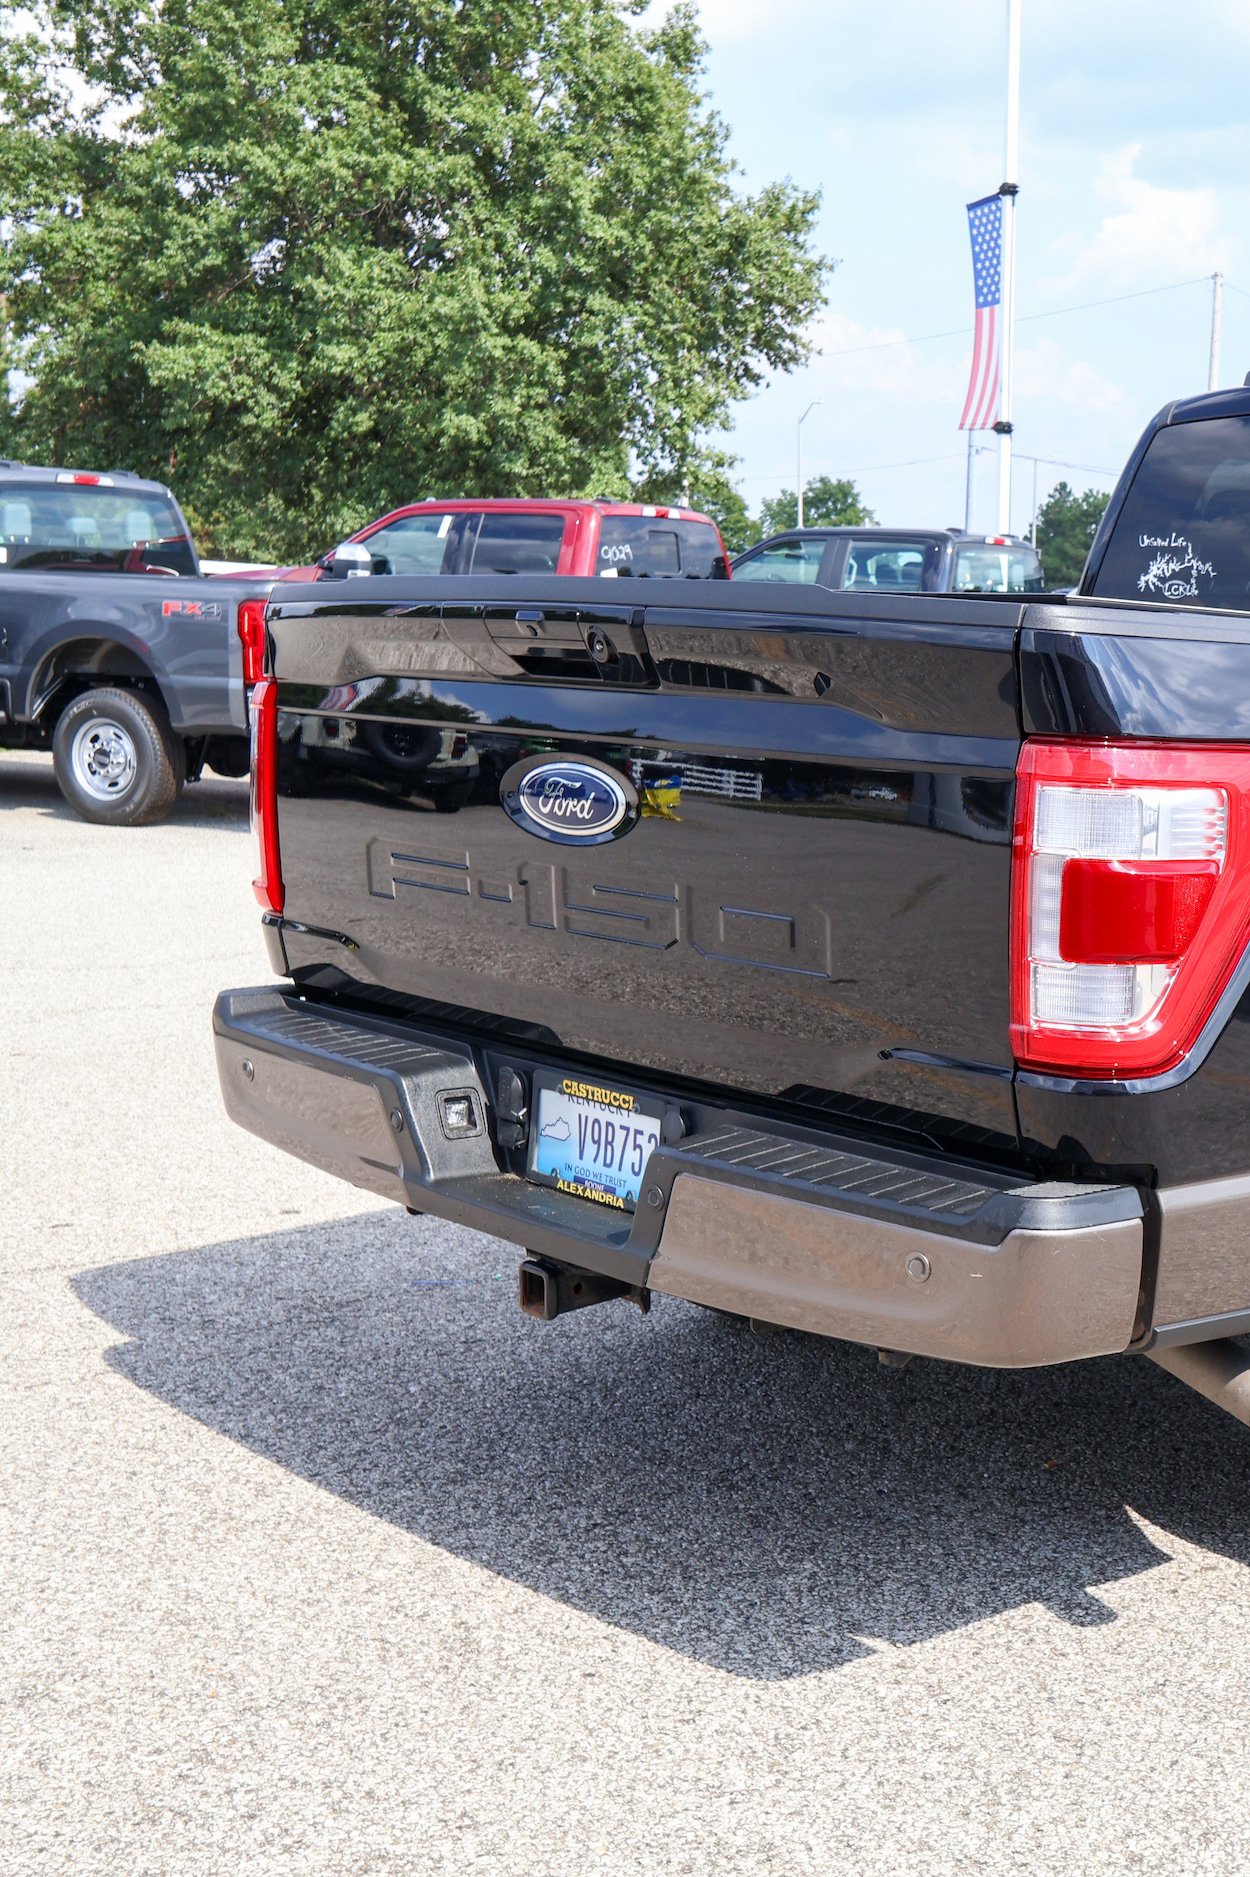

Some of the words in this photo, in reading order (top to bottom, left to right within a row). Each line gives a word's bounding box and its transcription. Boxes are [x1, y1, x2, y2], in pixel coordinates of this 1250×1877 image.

[601, 543, 634, 566] 9029
[162, 600, 222, 617] FX4
[538, 776, 596, 820] Ford
[366, 836, 831, 979] F-150
[562, 1079, 634, 1110] CASTRUCCI
[565, 1162, 573, 1172] IN
[574, 1166, 590, 1177] GOD
[592, 1171, 602, 1182] WE
[604, 1174, 627, 1189] TRUST
[556, 1180, 625, 1209] ALEXANDRIA
